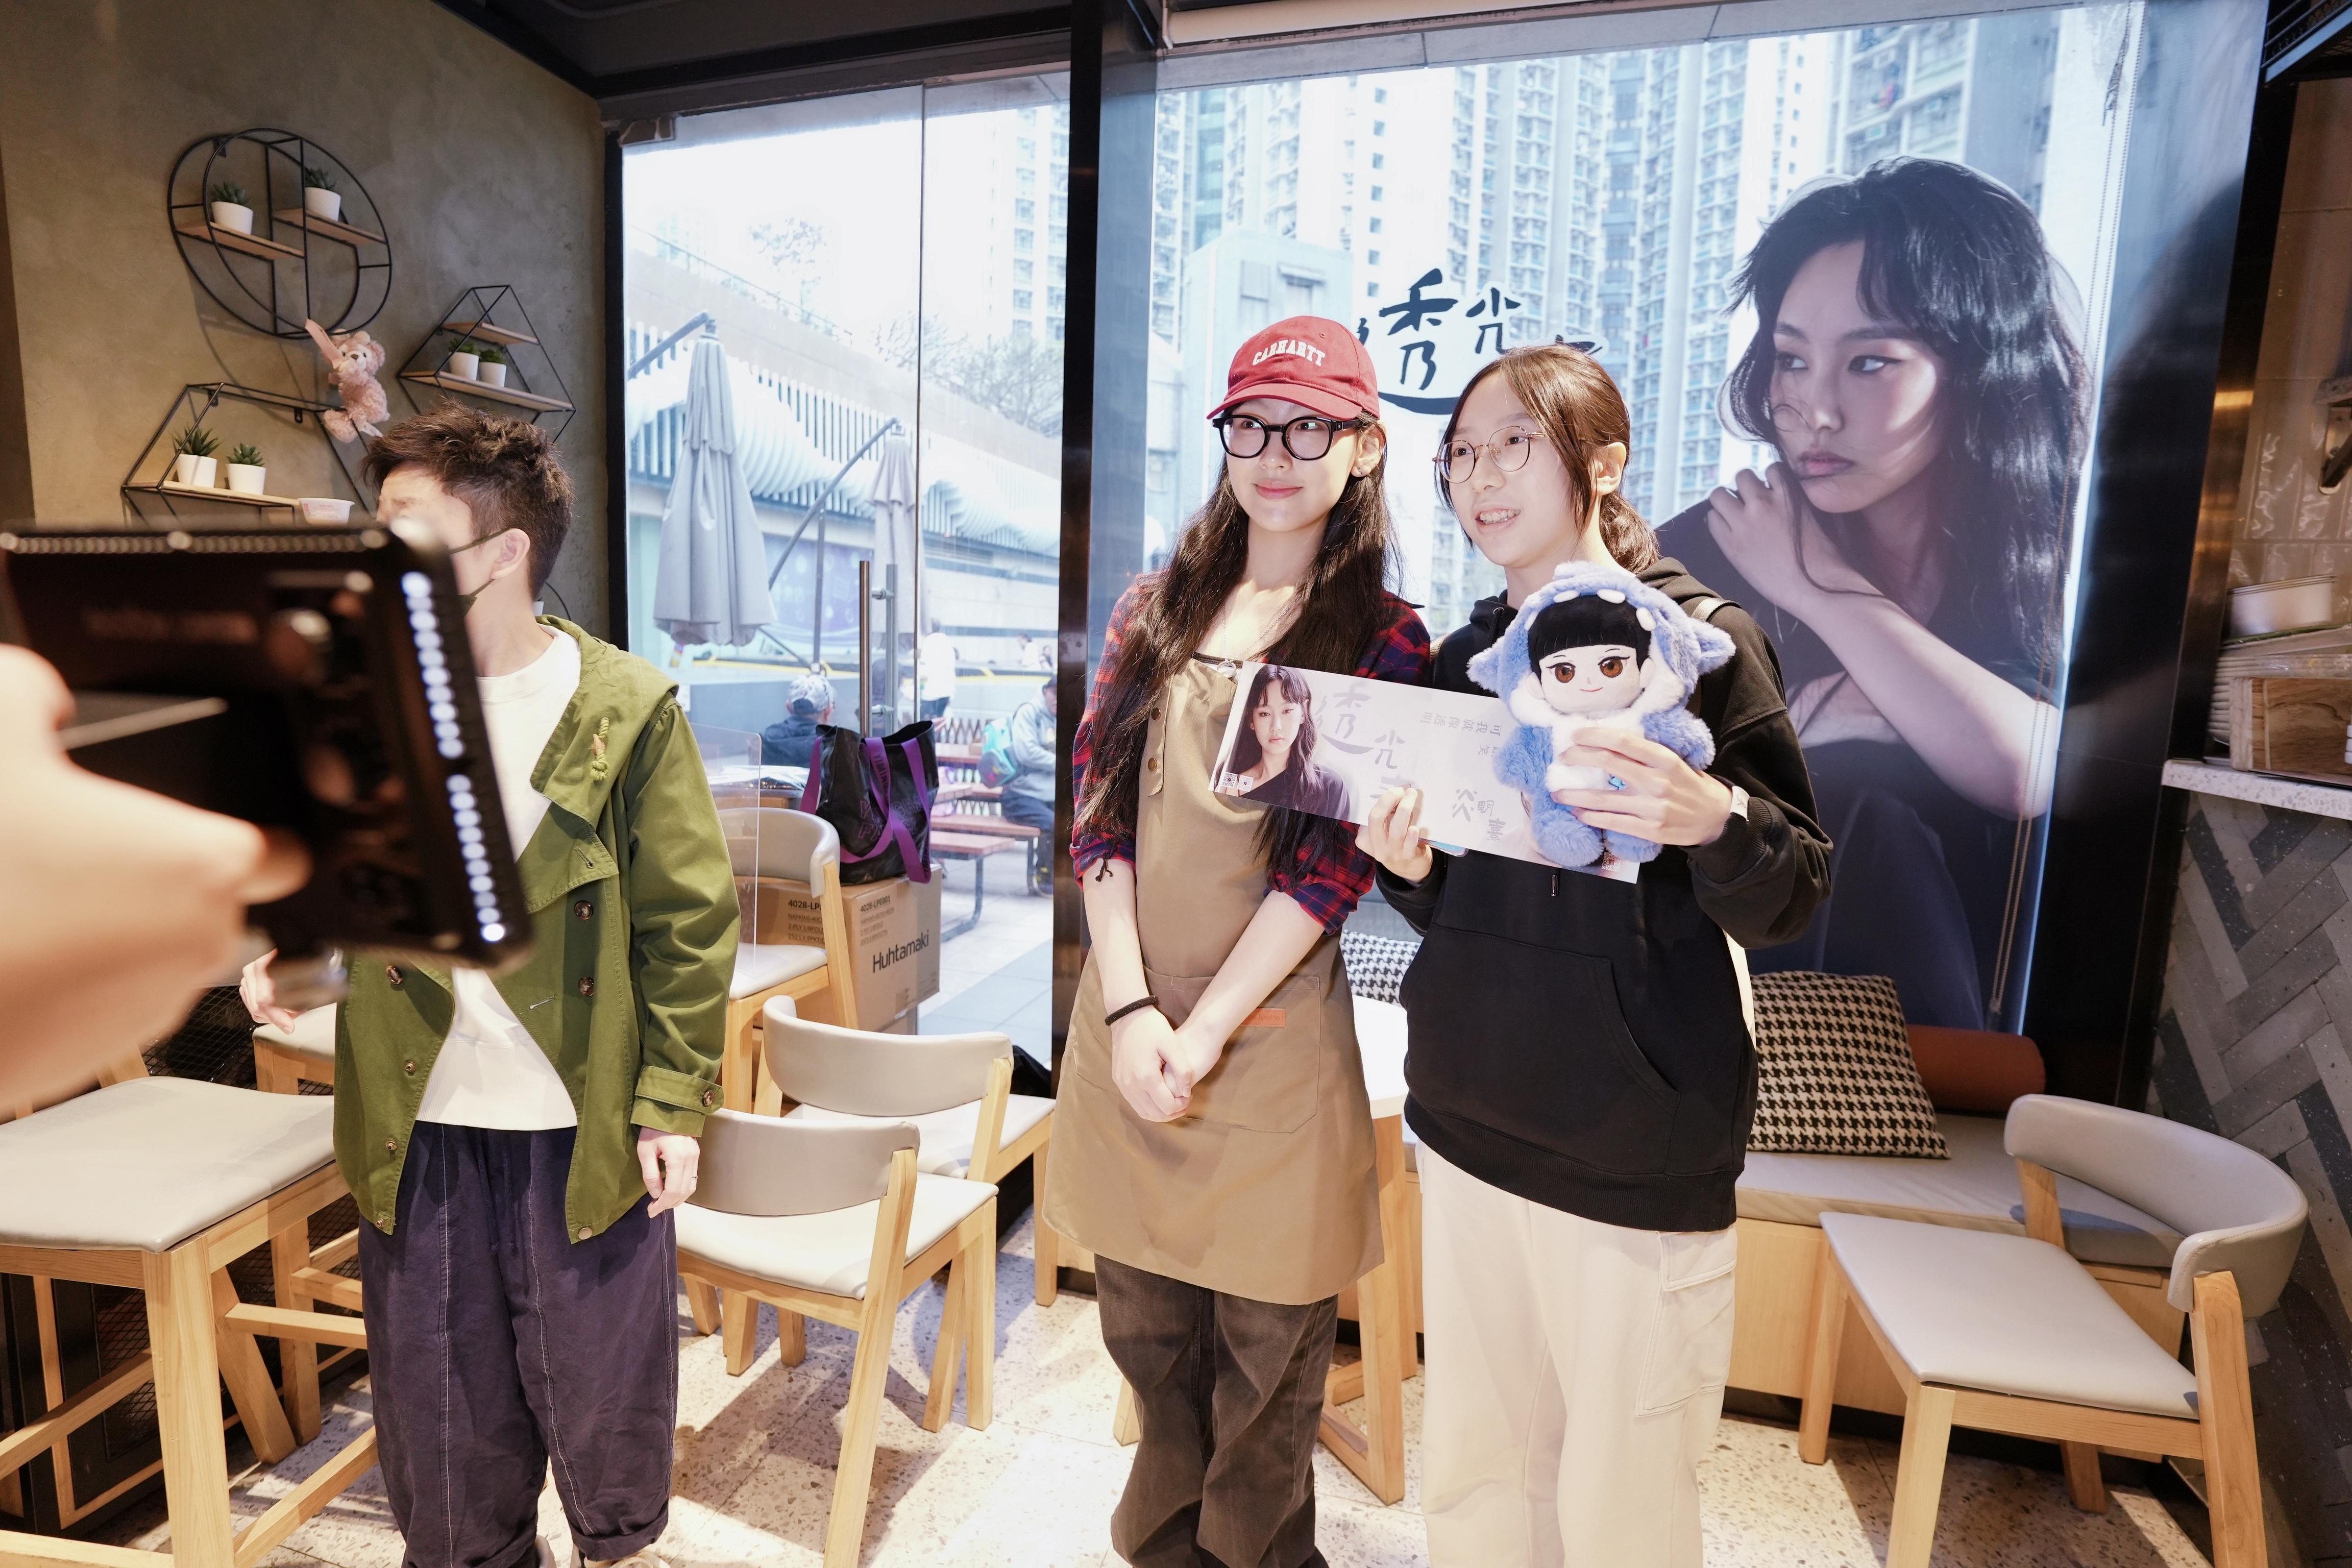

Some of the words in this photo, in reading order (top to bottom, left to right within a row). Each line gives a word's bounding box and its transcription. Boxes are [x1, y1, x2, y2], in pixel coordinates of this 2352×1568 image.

[1252, 339, 1326, 366] CARHARTT
[1357, 268, 1603, 414] 透光
[788, 899, 821, 911] 4028-LP
[873, 929, 929, 973] Huhtamaki
